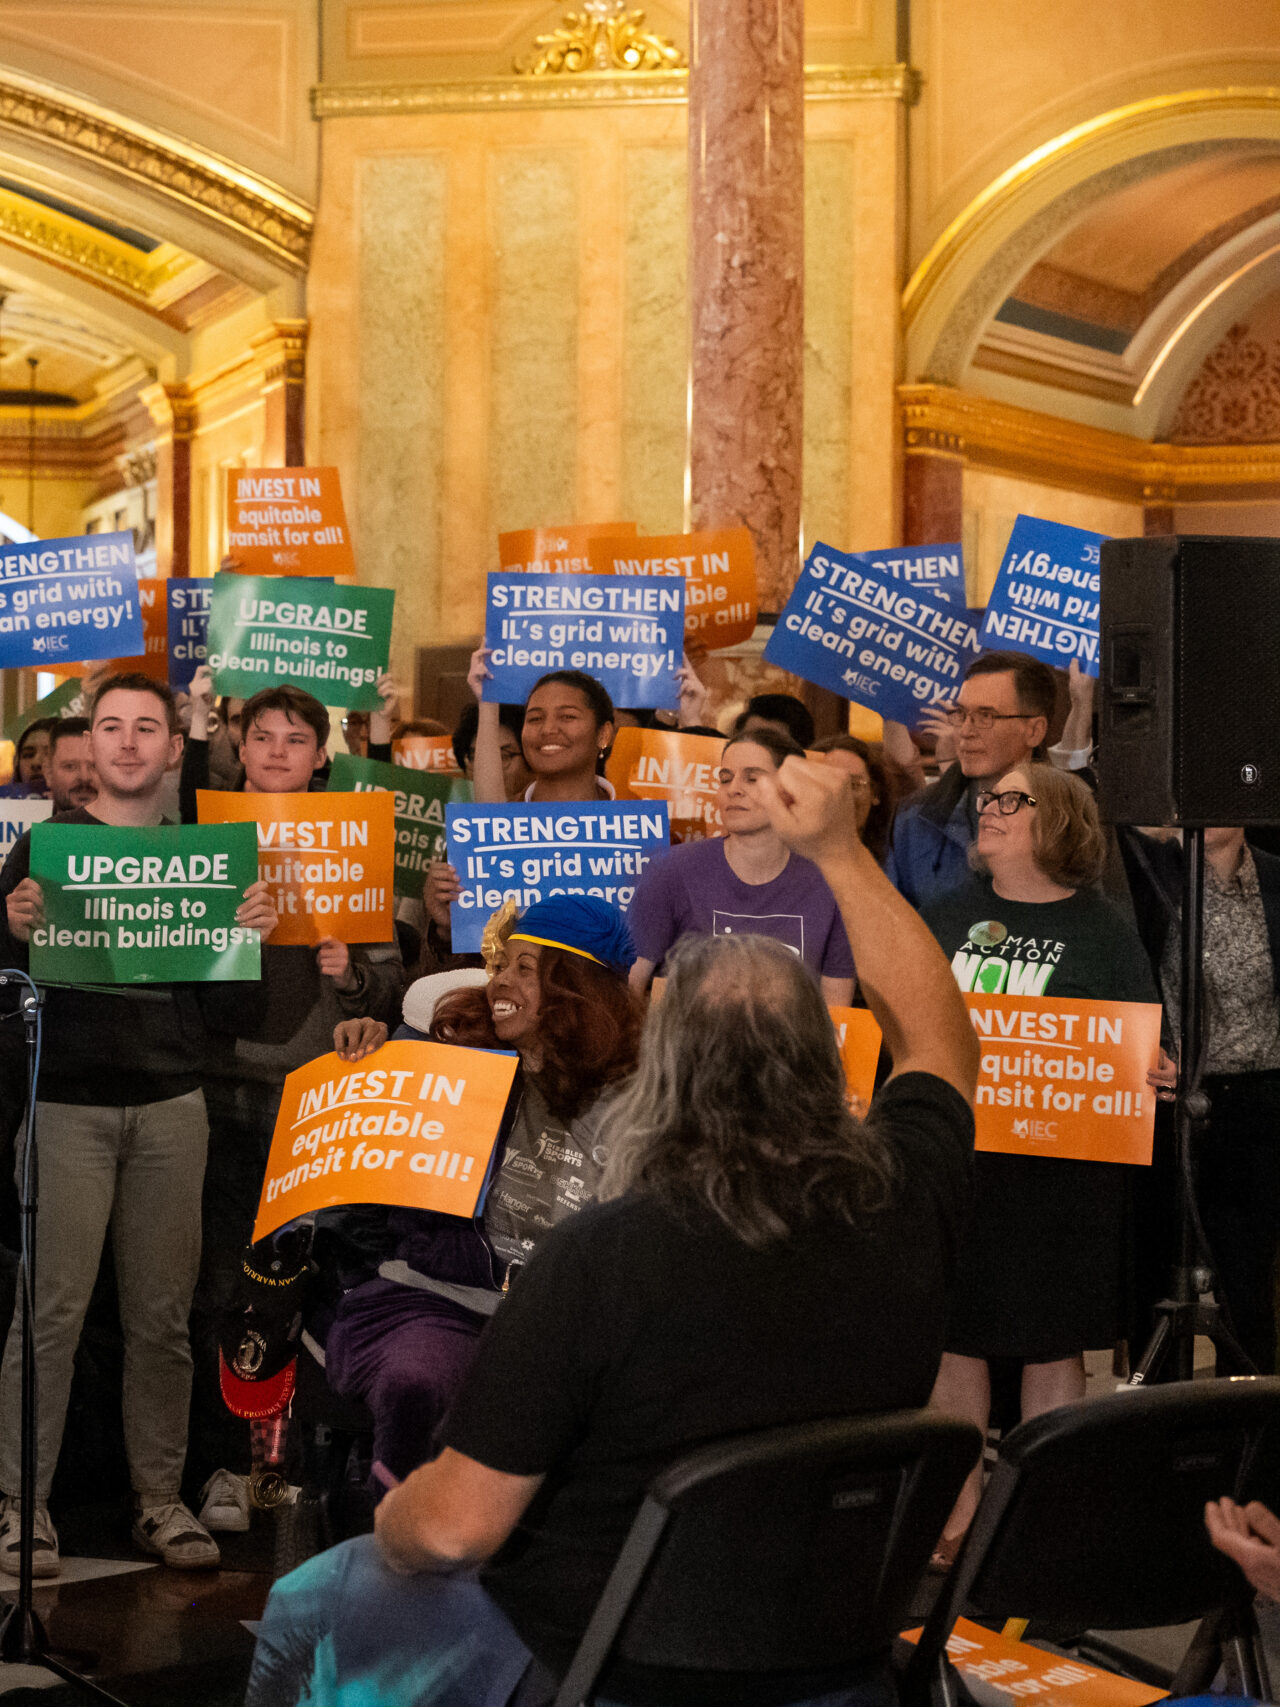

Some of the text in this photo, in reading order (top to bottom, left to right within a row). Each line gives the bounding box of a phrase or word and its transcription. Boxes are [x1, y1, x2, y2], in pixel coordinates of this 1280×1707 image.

[237, 478, 321, 497] INVEST IN
[239, 505, 322, 530] equitable
[283, 527, 309, 546] for
[314, 527, 344, 545] all!
[614, 552, 730, 577] INVEST IN
[1080, 547, 1100, 564] EC
[12, 582, 63, 613] grid
[67, 576, 122, 600] with
[491, 585, 680, 612] STRENGTHEN
[809, 556, 982, 654] STRENGTHEN
[1007, 581, 1100, 623] rid with
[36, 600, 133, 629] energy!
[182, 619, 206, 636] IL'
[239, 599, 368, 632] UPGRADE
[685, 603, 750, 630] or all!
[47, 635, 69, 650] IEC
[250, 632, 347, 659] Illinois to
[549, 620, 603, 648] grid
[609, 621, 667, 644] with
[847, 616, 904, 651] grid
[906, 641, 960, 679] with
[985, 611, 1100, 663] NGTHEN
[173, 641, 207, 659] cle
[491, 646, 674, 677] clean energy!
[786, 614, 959, 705] clean energy!
[208, 651, 383, 688] clean buildings!
[856, 674, 881, 696] IEC
[638, 756, 720, 790] INVES
[0, 821, 24, 844] IN
[257, 821, 334, 848] VEST
[341, 820, 368, 847] IN
[452, 813, 664, 843] STRENGTHEN
[67, 854, 229, 883] UPGRADE
[258, 857, 364, 884] uitable
[522, 852, 582, 885] grid
[588, 851, 650, 876] with
[85, 897, 207, 920] Illinois to
[304, 888, 343, 914] for
[348, 887, 385, 913] all!
[457, 885, 541, 909] clean
[33, 923, 253, 952] clean buildings!
[1006, 935, 1065, 953] MATE
[959, 941, 1061, 963] ACTION
[951, 950, 1056, 996] NOW
[970, 1008, 1122, 1044] NVEST IN
[981, 1050, 1115, 1082] quitable
[296, 1070, 466, 1121] INVEST IN
[976, 1081, 1142, 1117] nsit for all!
[292, 1110, 445, 1157] equitable
[1030, 1120, 1058, 1138] IEC
[544, 1148, 582, 1168] SPORTS
[266, 1142, 475, 1203] transit for all!
